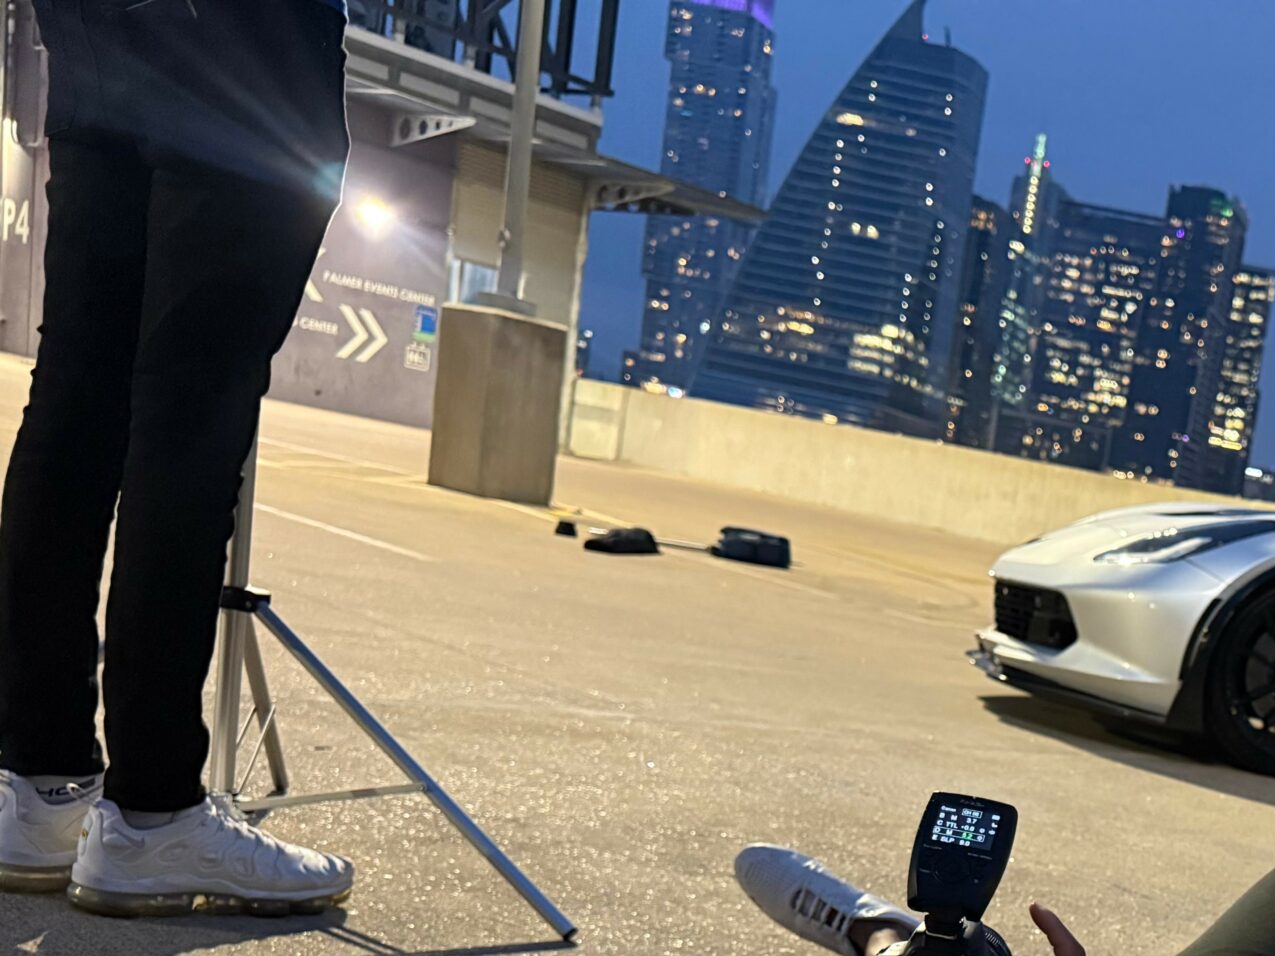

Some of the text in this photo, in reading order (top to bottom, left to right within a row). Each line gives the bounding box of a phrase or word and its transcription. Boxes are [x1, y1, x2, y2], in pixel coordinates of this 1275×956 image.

[3, 197, 30, 244] P4
[323, 270, 436, 307] PALMER EVENTS CENTER
[299, 316, 339, 336] CENTER
[946, 821, 958, 829] TTL
